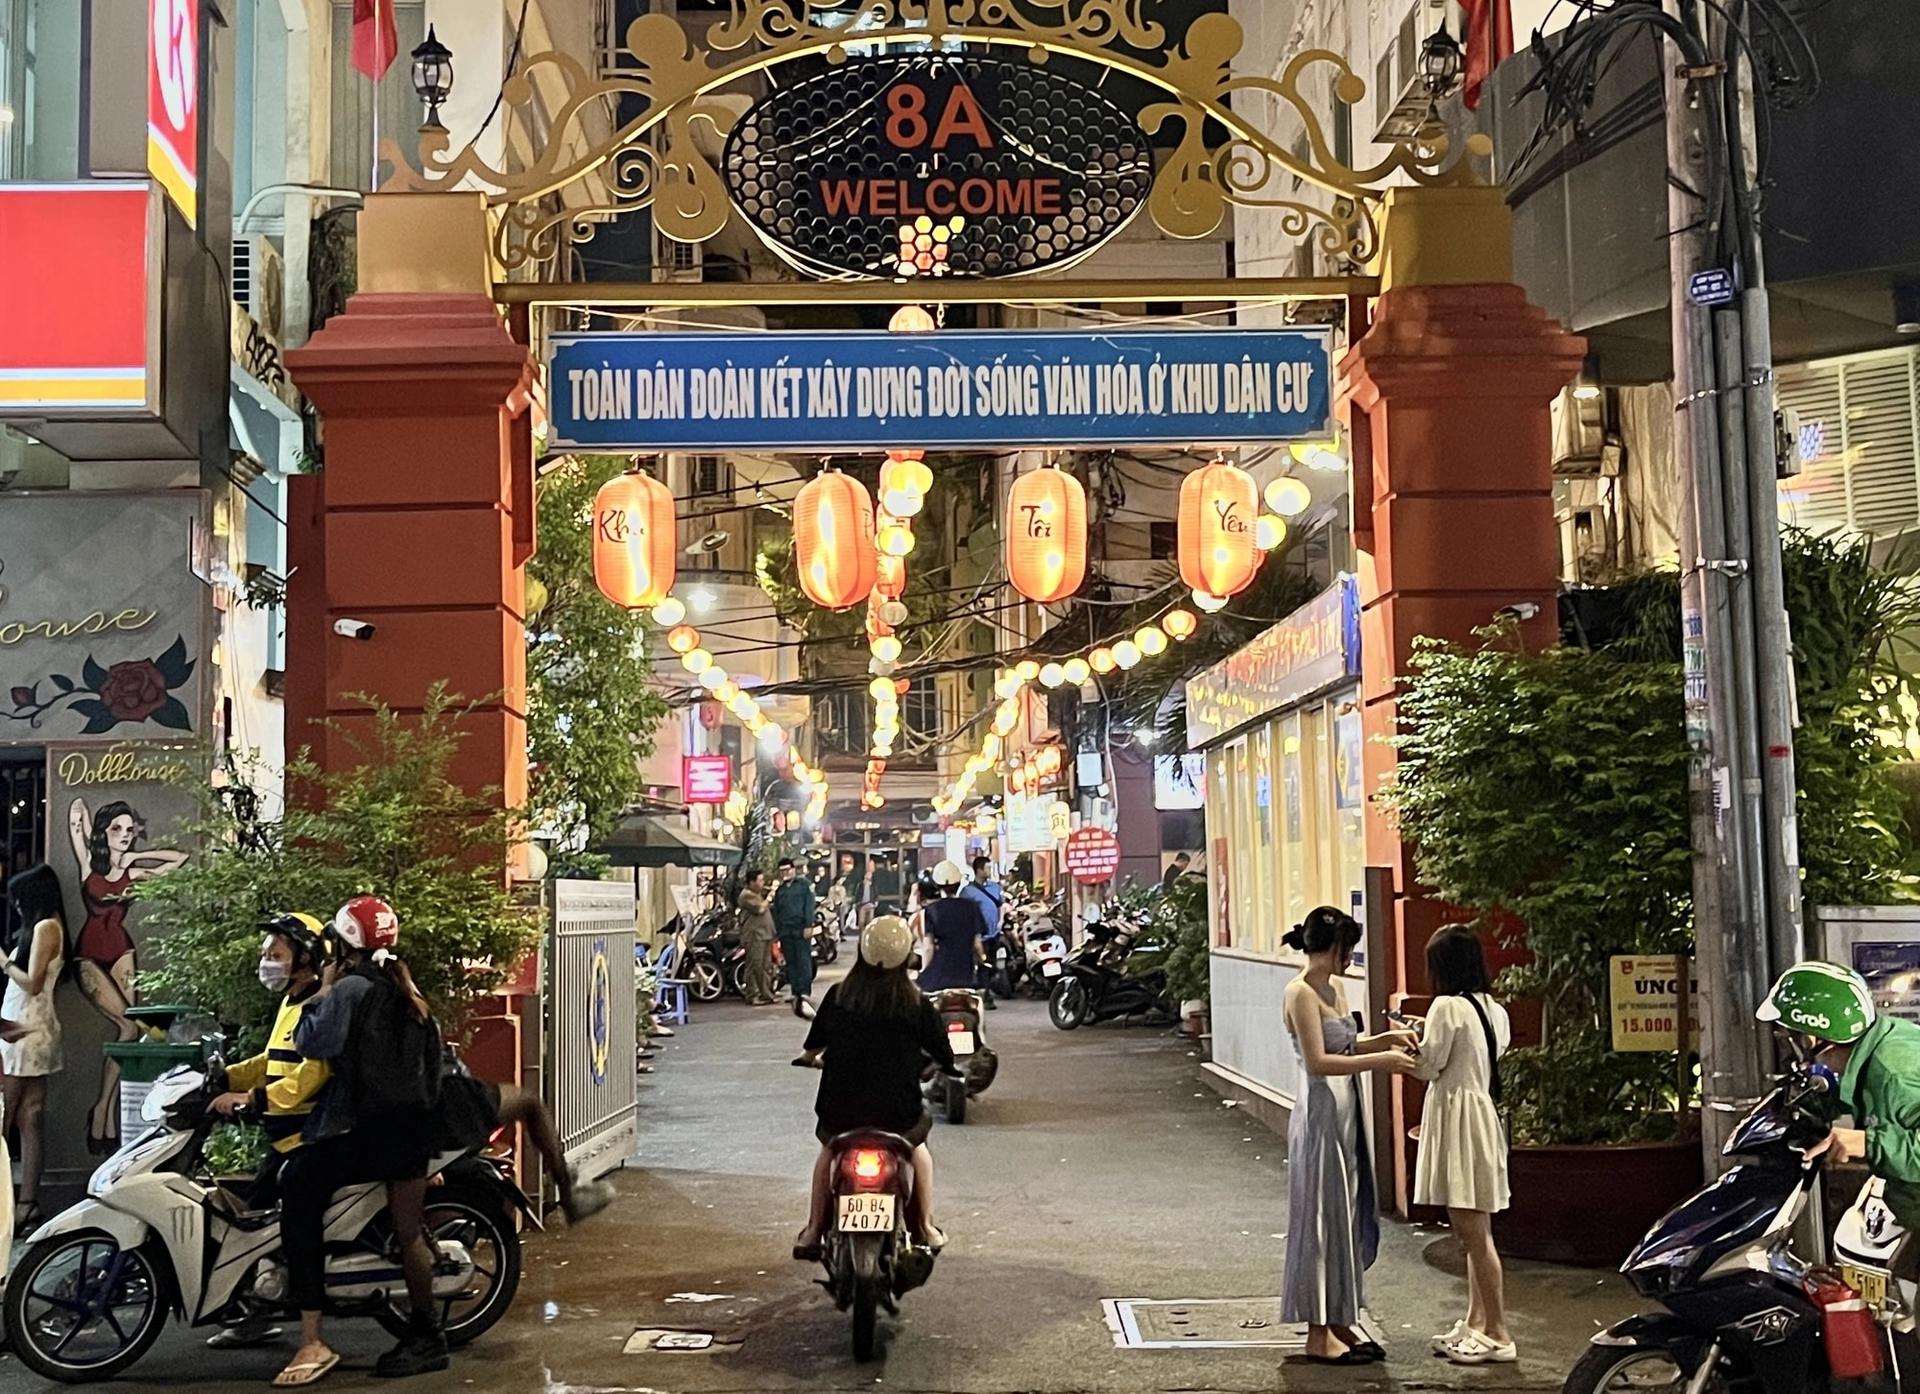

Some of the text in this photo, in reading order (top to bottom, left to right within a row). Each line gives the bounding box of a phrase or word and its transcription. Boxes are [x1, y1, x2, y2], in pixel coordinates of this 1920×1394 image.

[884, 83, 994, 150] 8A
[819, 177, 1063, 217] WELCOME
[568, 352, 1314, 425] TOÀN DÂN ĐOÀN KẾT XÂY DỰNG ĐỜI SỐNG VĂN HÓA Ở KHU DÂN CƯ
[1790, 1008, 1831, 1029] Grab
